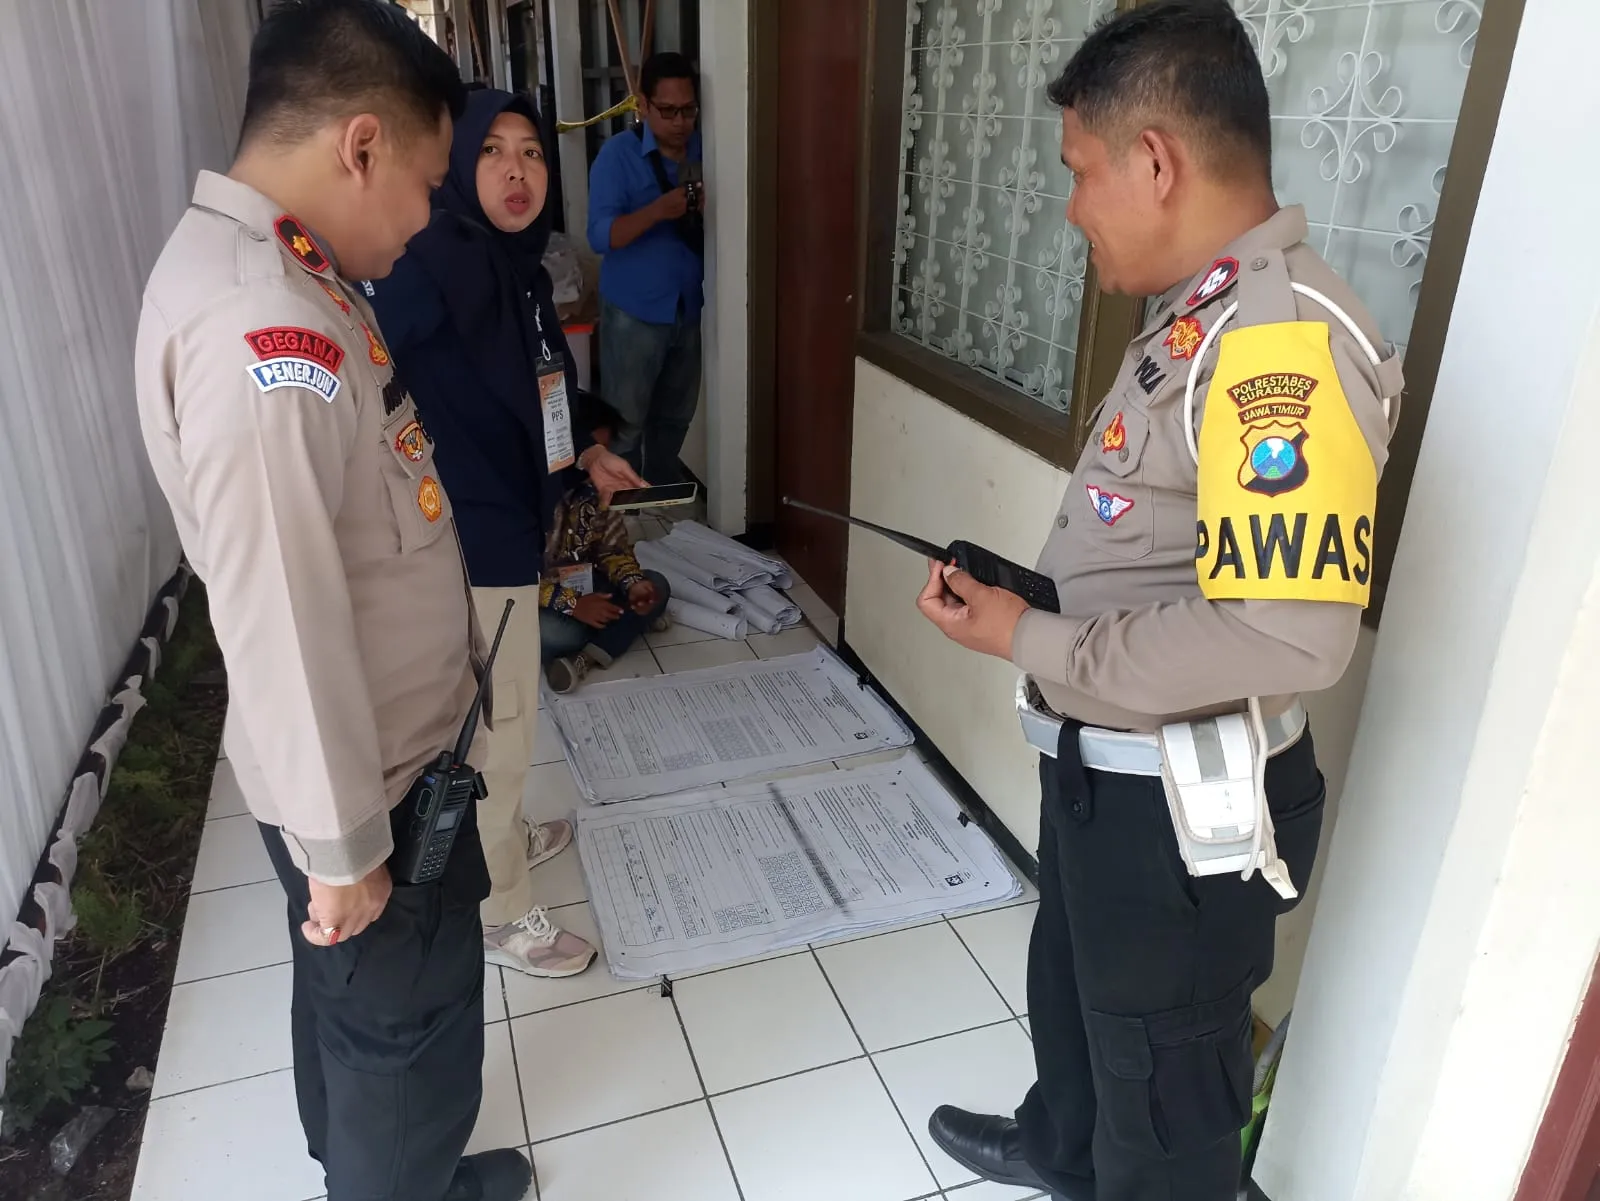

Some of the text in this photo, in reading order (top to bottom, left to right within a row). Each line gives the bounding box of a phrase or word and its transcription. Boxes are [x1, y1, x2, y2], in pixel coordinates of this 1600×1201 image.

[257, 332, 336, 364] GEGANA
[262, 361, 334, 395] PENERJUN
[1232, 375, 1312, 398] POLRESTABES
[1239, 386, 1305, 404] SURABAYA
[1243, 405, 1305, 421] JAWA TIMUR
[1195, 512, 1371, 586] PAWAS
